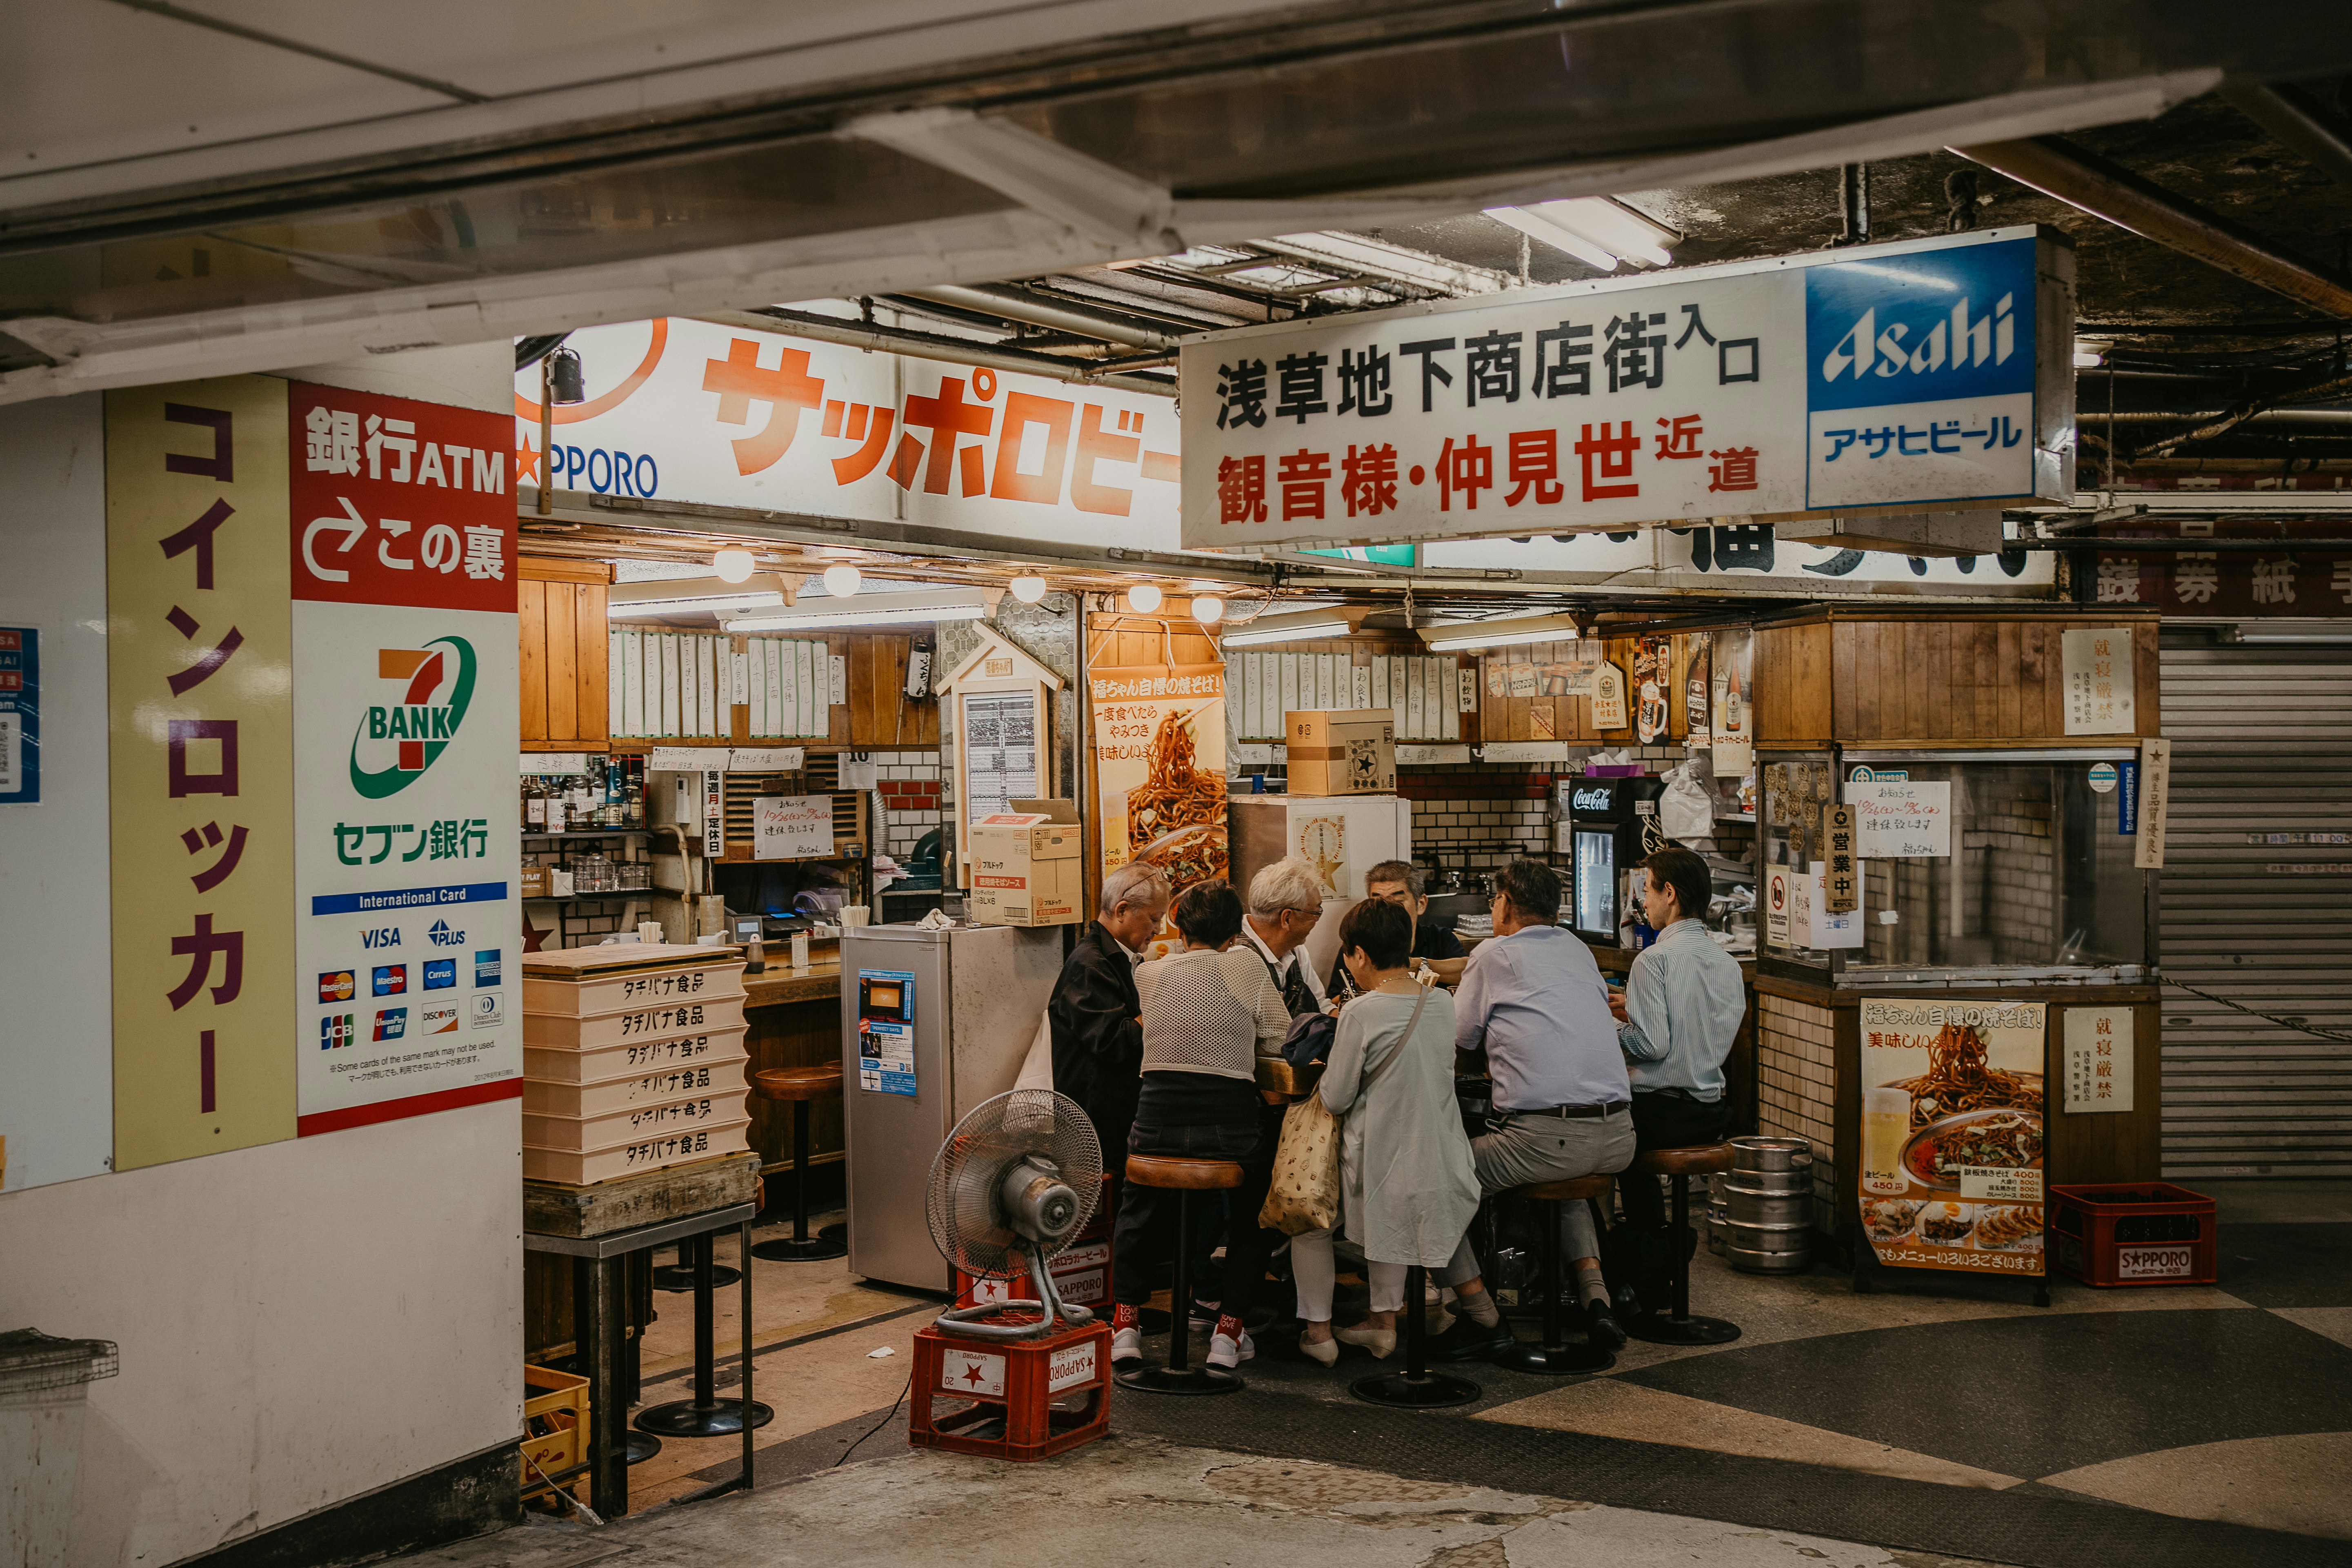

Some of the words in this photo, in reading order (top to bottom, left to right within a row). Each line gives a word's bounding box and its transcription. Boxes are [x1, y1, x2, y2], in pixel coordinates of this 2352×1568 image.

[1823, 291, 2014, 382] Asahi
[1216, 304, 1759, 430] 浅草地下商店街入口
[702, 338, 1181, 517] サッポロビー
[1824, 416, 2022, 463] アサヒビール
[306, 406, 505, 495] 銀行ATM
[1217, 414, 1760, 525] 観音様・仲見世近道
[378, 518, 505, 581] この裏
[751, 647, 763, 702] ハイボール
[767, 650, 778, 699] 日本酒
[816, 651, 827, 714] 生ビール
[1286, 661, 1294, 700] ラーメン
[1393, 665, 1403, 705] 日本酒
[1409, 662, 1420, 714] サワー各種
[1443, 666, 1456, 710] 瓶ビール
[1511, 678, 1536, 690] HOPPY
[2094, 638, 2113, 721] 就寝厳禁
[1356, 672, 1367, 708] お食事
[1427, 665, 1438, 715] 生ビール
[1462, 673, 1472, 705] お飲物
[369, 705, 451, 739] BANK
[1095, 705, 1158, 722] 一度食べたら
[1109, 724, 1149, 738] やみつき
[158, 402, 250, 1114] コインロッカー
[1398, 748, 1438, 763] 黒霧島
[778, 800, 807, 809] お知らせ
[1878, 787, 1916, 798] お知らせ
[765, 824, 816, 836] 連休致します
[1866, 818, 1931, 831] 連休致します
[333, 819, 488, 865] セブン銀行
[1901, 843, 1937, 855] 福ちゃん
[982, 861, 1003, 870] ブルドック
[1832, 832, 1850, 895] 営業中
[360, 891, 435, 908] International
[440, 887, 466, 901] Card
[358, 927, 402, 949] VISA
[438, 930, 465, 947] PLUS
[1825, 919, 1849, 929] 土曜日
[475, 961, 500, 970] AMERICAN
[479, 969, 502, 977] EXPRESS
[320, 981, 353, 993] MasterCard
[376, 975, 403, 985] Maestro
[427, 970, 451, 980] Cirrus
[376, 1015, 405, 1027] UnionPay
[423, 1009, 457, 1021] DISCOVER
[489, 1011, 501, 1020] Club
[622, 1005, 704, 1035] タチバナ食品
[321, 1025, 353, 1040] JCB
[360, 1059, 380, 1070] cards
[382, 1058, 389, 1067] of
[390, 1056, 401, 1066] the
[402, 1053, 421, 1063] same
[423, 1048, 440, 1059] mark
[442, 1048, 456, 1058] may
[457, 1044, 468, 1054] not
[469, 1043, 478, 1052] be
[478, 1040, 496, 1050] used.
[2096, 1017, 2112, 1099] 就寝厳禁
[629, 1068, 710, 1099] チバナ食品
[627, 1132, 708, 1166] タチバナ食品
[1864, 1170, 1894, 1179] 生ビール
[1964, 1168, 2010, 1178] 鉄板焼きそば
[1049, 1248, 1107, 1270] ッポロラガービール
[1058, 1277, 1102, 1297] SAPPORO
[1220, 1320, 1235, 1330] LOVE
[963, 1352, 987, 1361] SAPPORO
[1050, 1356, 1086, 1382] SAPPORO
